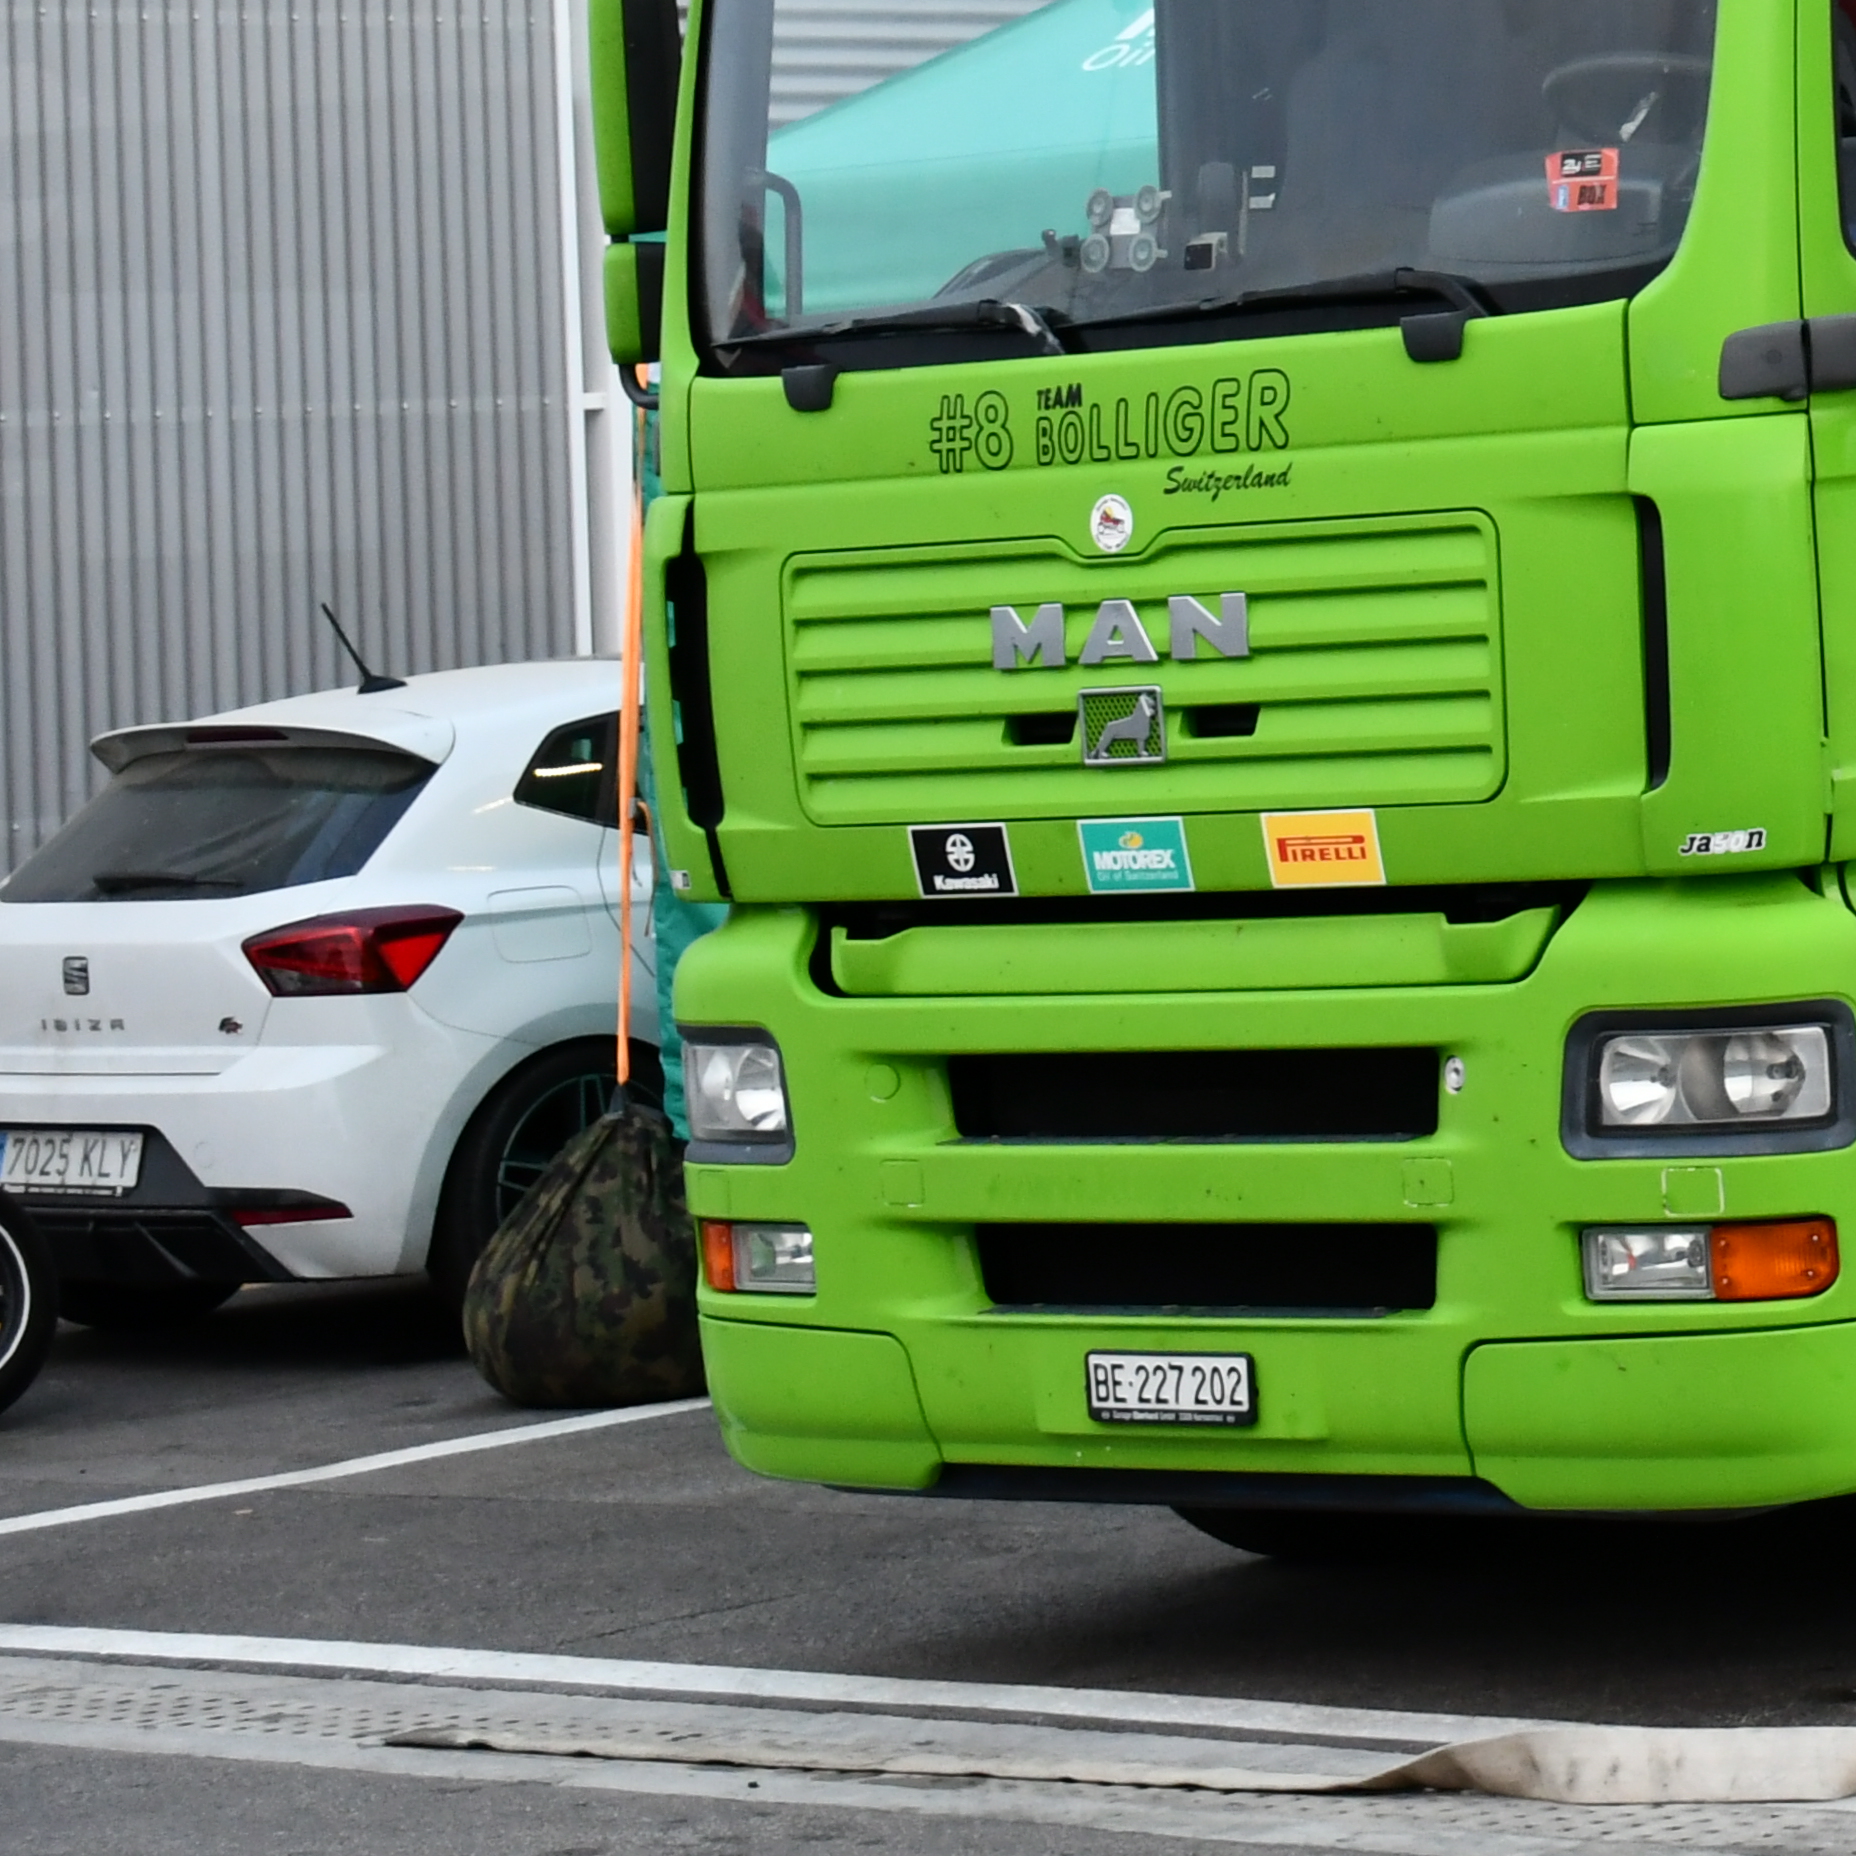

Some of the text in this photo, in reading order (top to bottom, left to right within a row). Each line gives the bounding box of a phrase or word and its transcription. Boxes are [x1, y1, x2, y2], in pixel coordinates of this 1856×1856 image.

[1034, 382, 1083, 412] TEAM
[929, 368, 1292, 474] #8 BOLLIGER
[1162, 461, 1293, 502] Switzerland
[989, 591, 1250, 669] MAN
[1093, 849, 1175, 870] MOTOREX
[1276, 835, 1367, 864] PIRELLI
[933, 873, 1000, 891] Kawasaki
[41, 1018, 125, 1032] IBIZA
[8, 1137, 135, 1179] 7025 KLY
[1135, 1361, 1184, 1405] 227
[1191, 1366, 1243, 1406] 202
